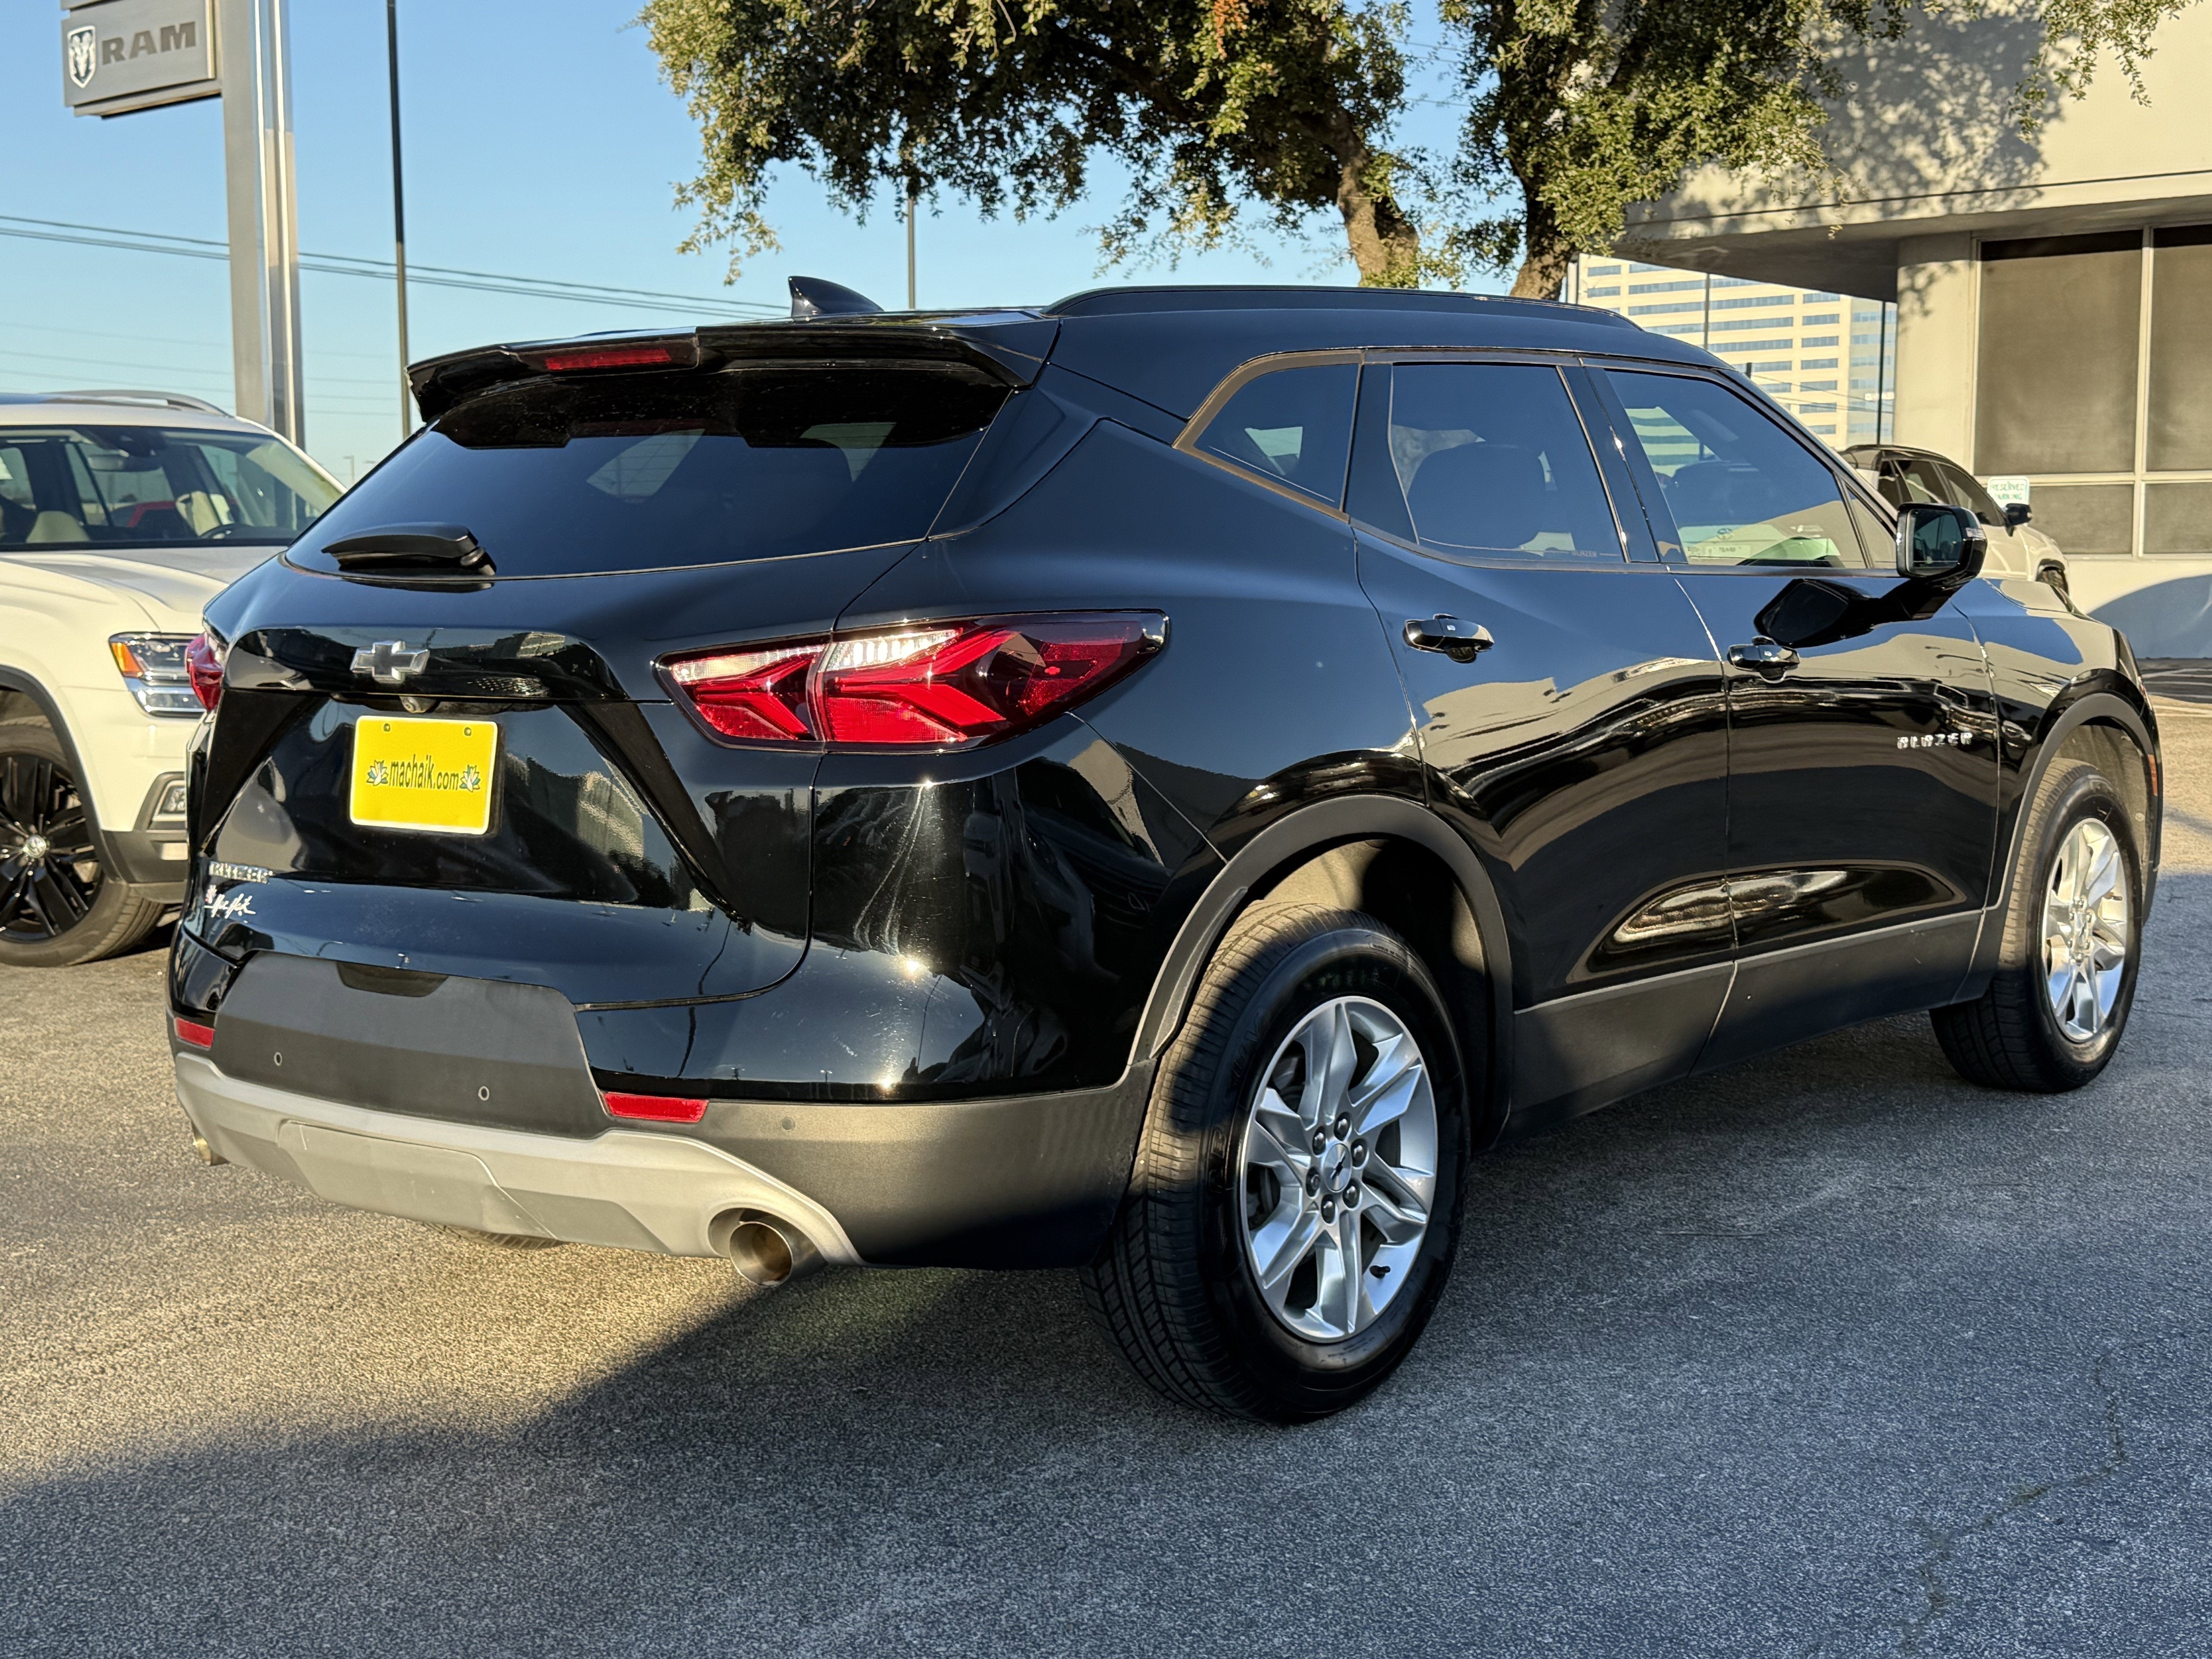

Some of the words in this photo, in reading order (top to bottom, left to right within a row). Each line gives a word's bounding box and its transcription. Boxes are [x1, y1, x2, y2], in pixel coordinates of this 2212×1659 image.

[102, 21, 196, 65] RAM
[1897, 732, 1973, 749] BLAZER
[389, 754, 459, 790] machaik.com
